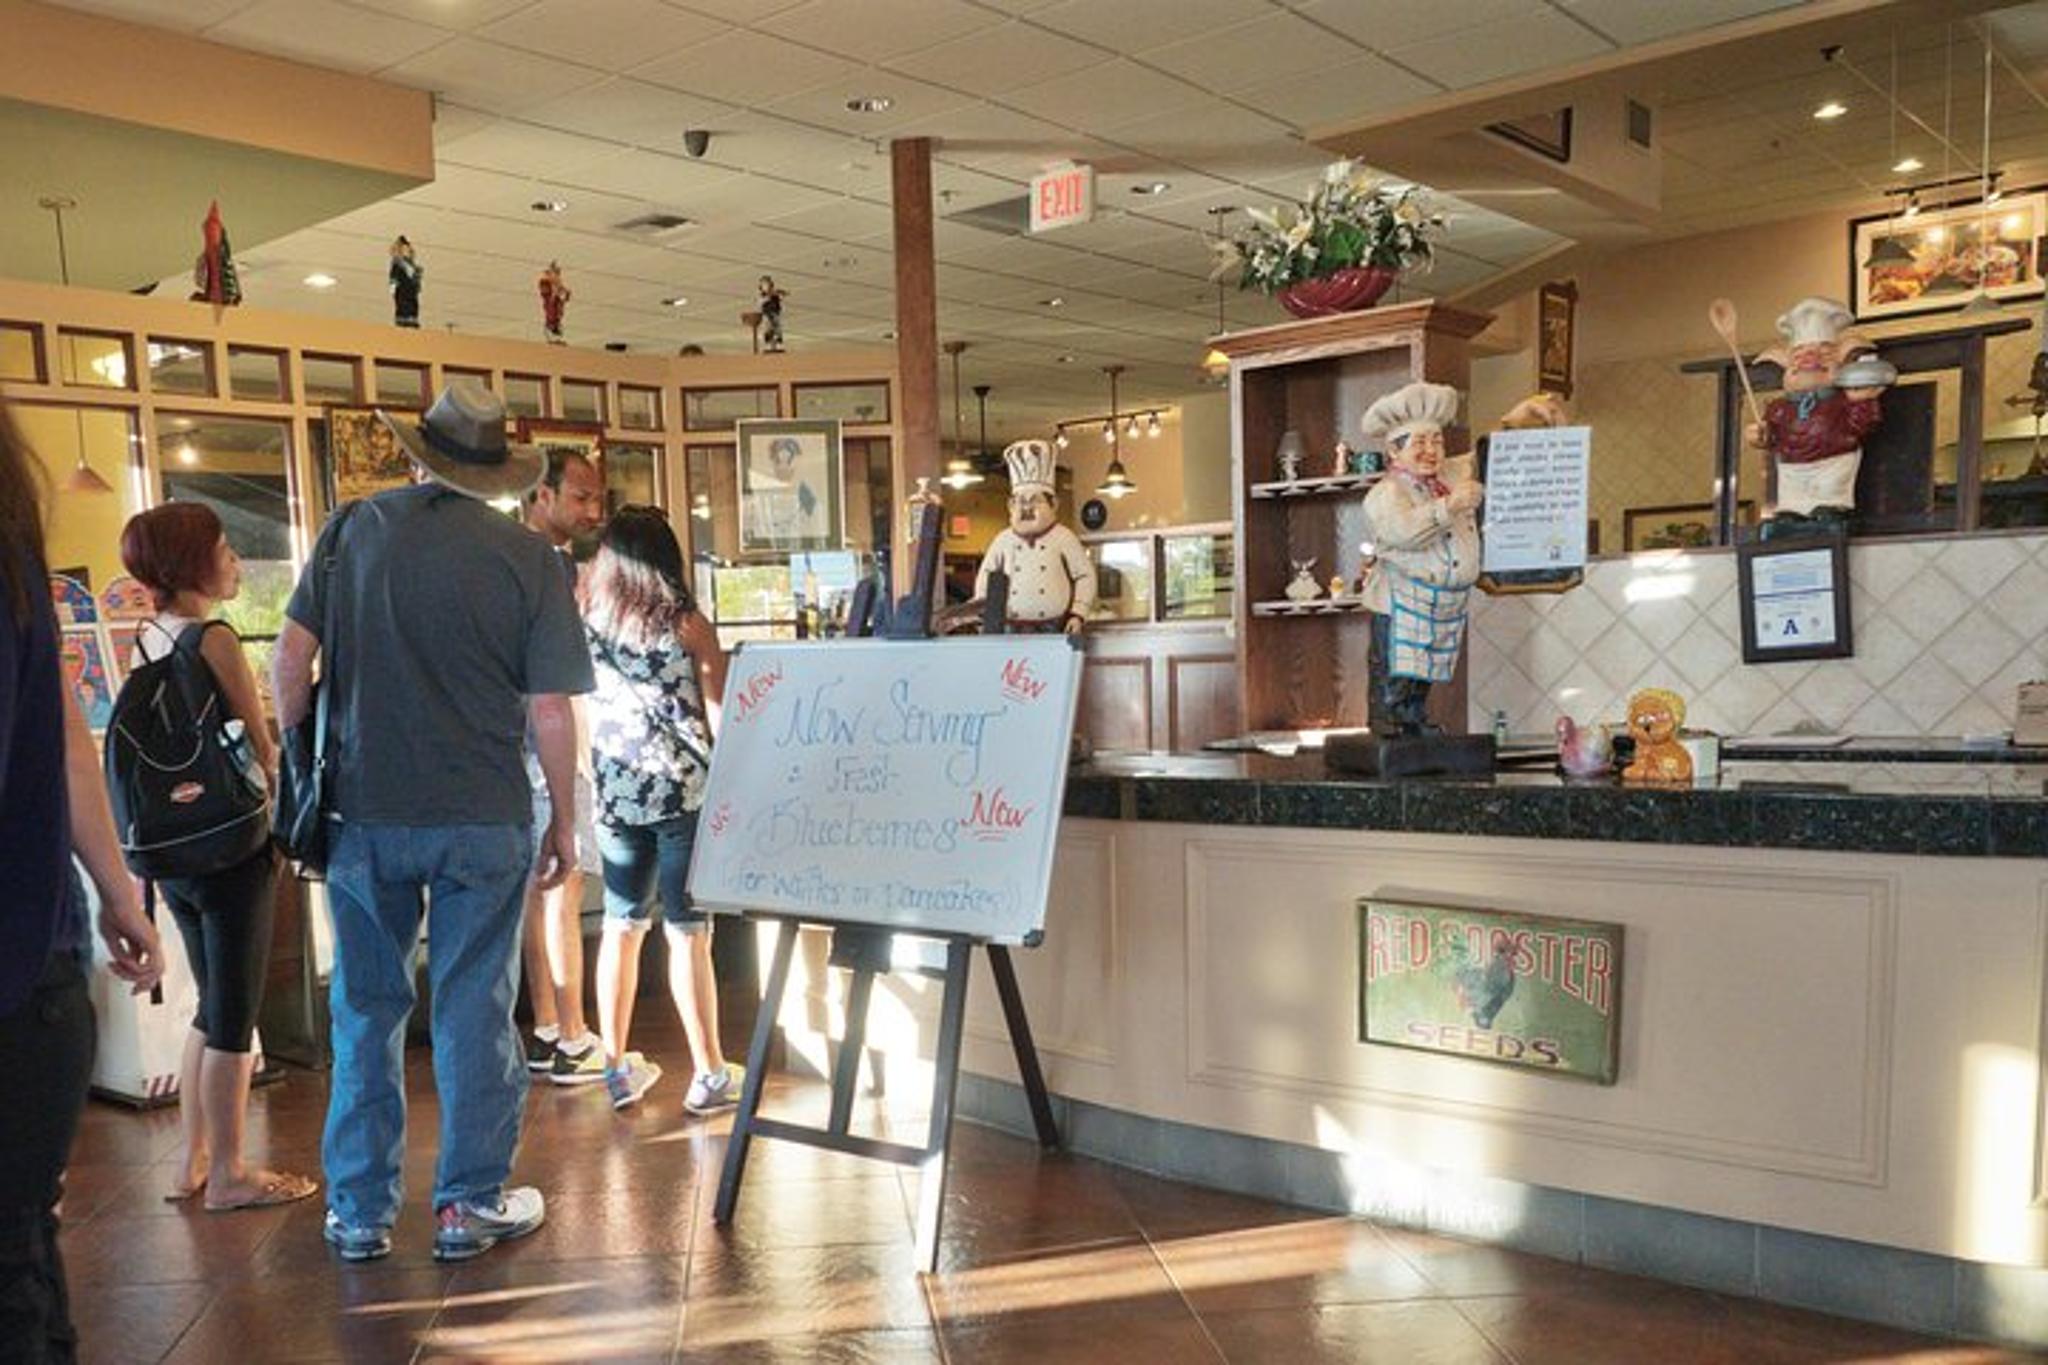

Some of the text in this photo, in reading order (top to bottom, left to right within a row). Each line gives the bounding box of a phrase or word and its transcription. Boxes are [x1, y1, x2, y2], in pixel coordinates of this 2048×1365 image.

[1040, 172, 1084, 220] EXIT
[774, 676, 865, 748] Now
[1367, 914, 1431, 984] RED
[1407, 1021, 1561, 1065] SEEDS
